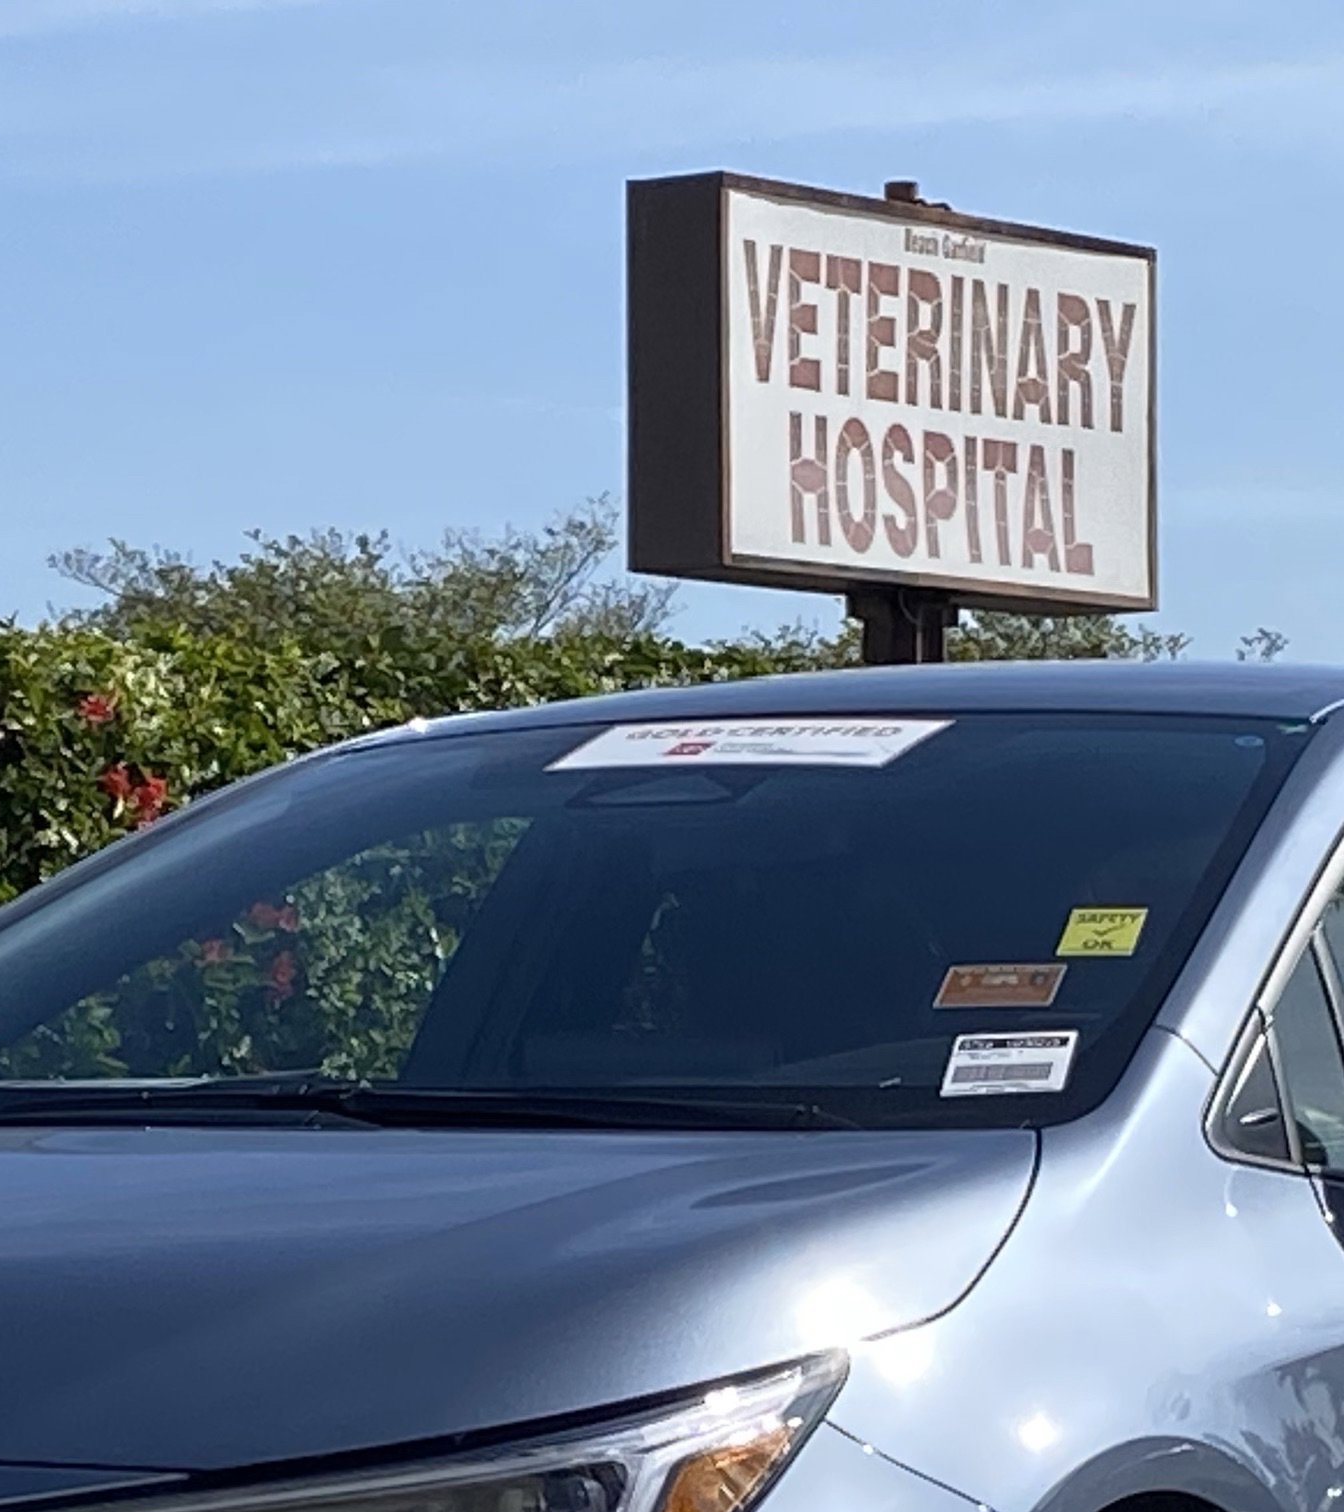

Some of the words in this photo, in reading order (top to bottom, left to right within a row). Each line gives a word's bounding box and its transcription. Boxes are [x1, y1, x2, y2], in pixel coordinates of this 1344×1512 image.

[743, 239, 1137, 433] VETERINARY
[789, 411, 1095, 575] HOSPITAL
[625, 727, 725, 740] GOLD
[728, 726, 903, 738] CERTIFIED
[1076, 913, 1142, 924] SAFETY
